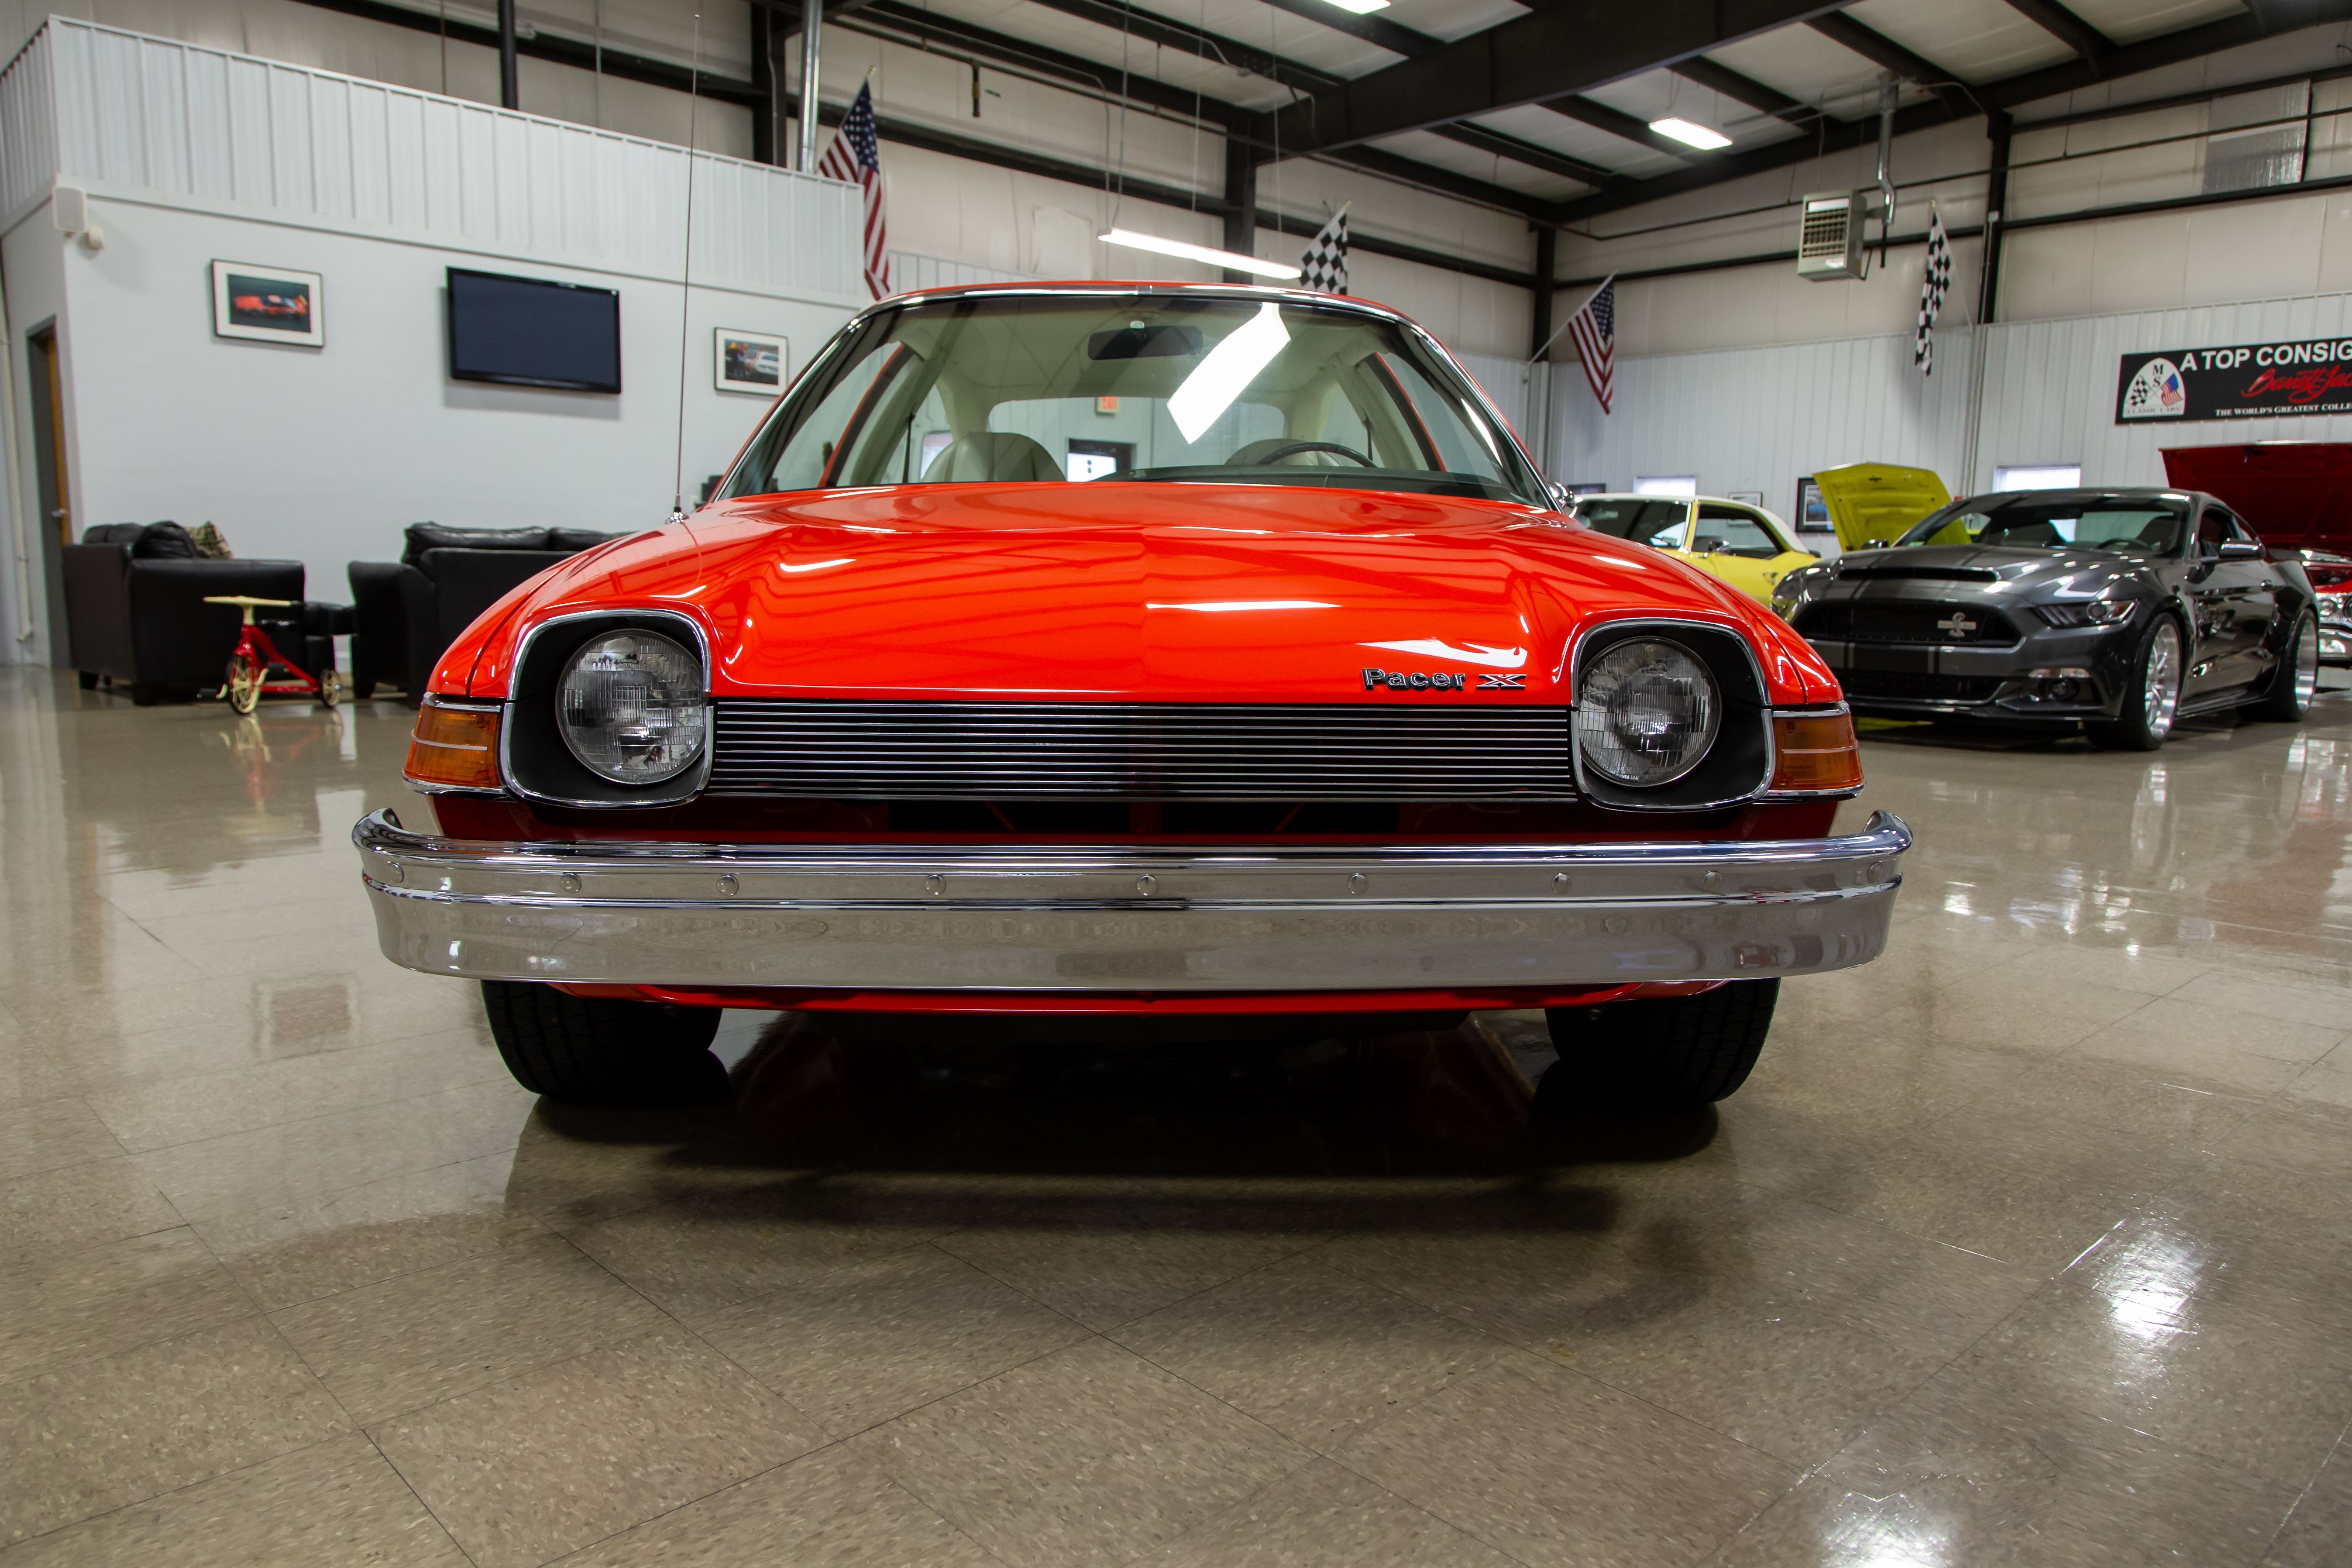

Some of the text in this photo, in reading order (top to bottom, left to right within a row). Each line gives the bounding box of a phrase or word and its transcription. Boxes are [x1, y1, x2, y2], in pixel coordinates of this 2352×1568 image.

[2180, 340, 2352, 372] A TOP CONSIG
[2234, 406, 2273, 415] WORLD'S
[2274, 404, 2319, 413] GREATEST
[2321, 402, 2352, 411] COLLE
[1361, 668, 1527, 691] Pacer X
